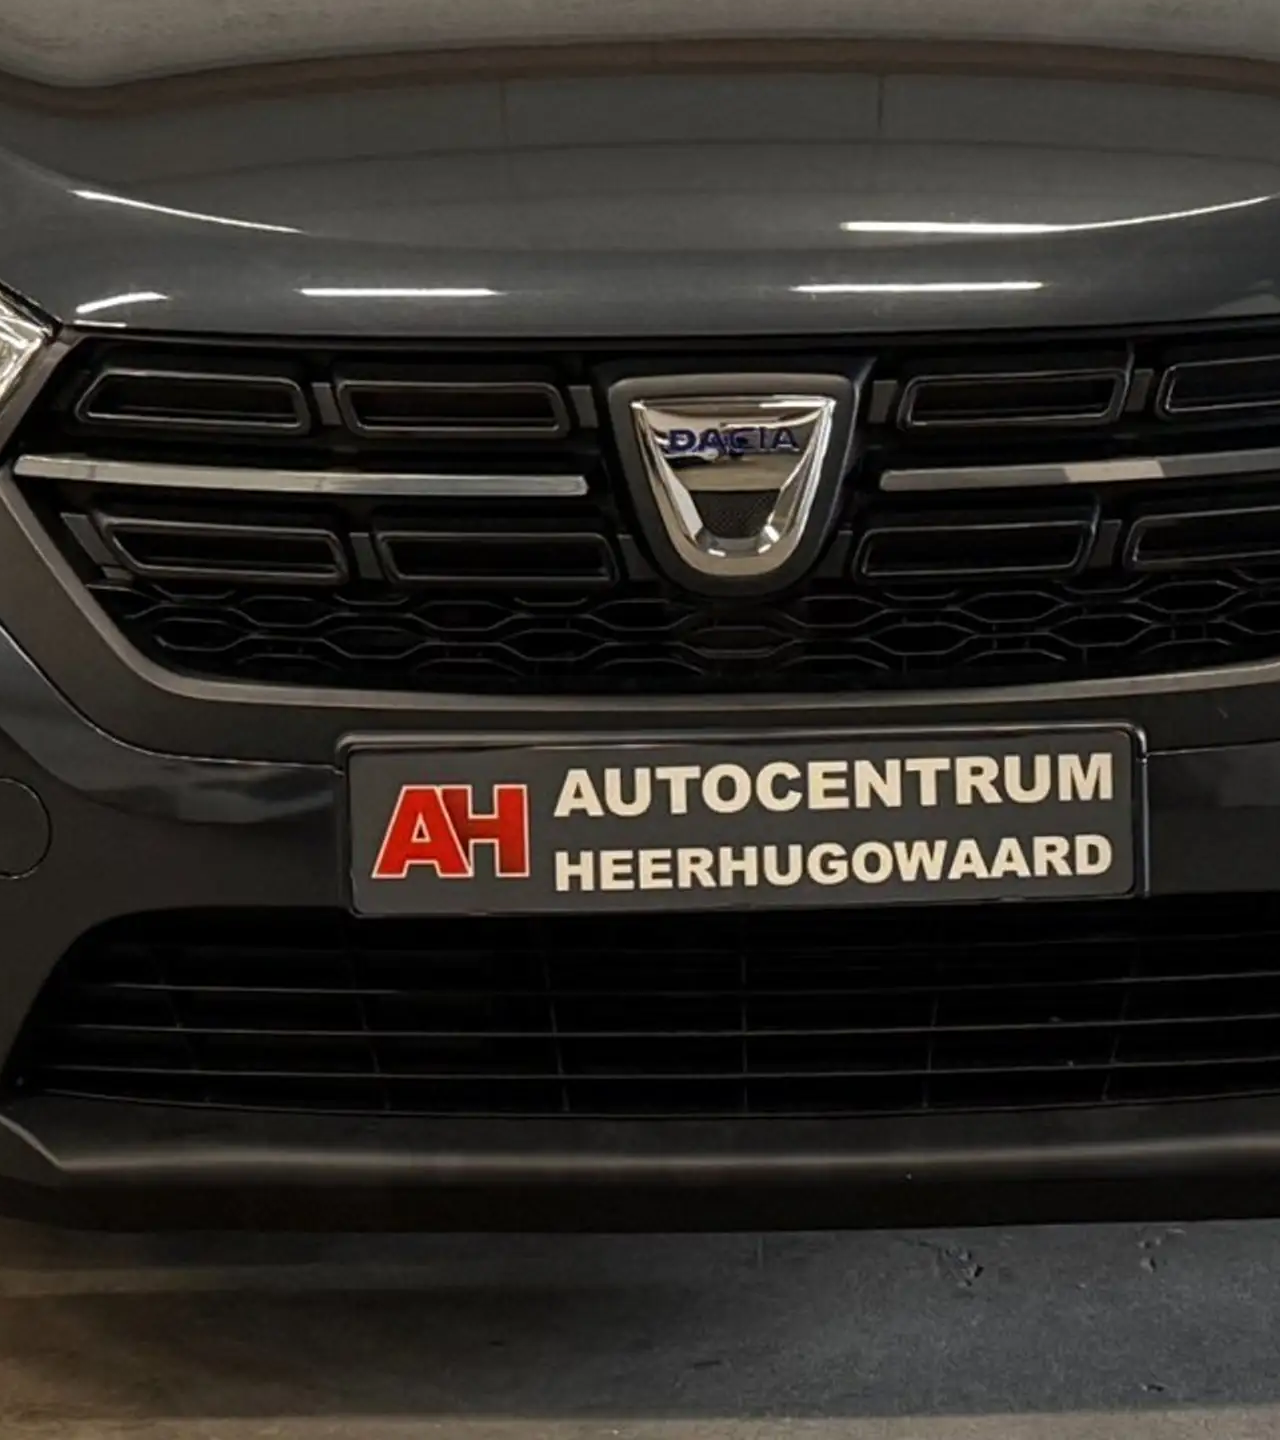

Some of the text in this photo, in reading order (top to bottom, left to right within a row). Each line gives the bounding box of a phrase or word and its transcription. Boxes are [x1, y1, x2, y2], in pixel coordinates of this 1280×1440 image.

[666, 426, 798, 452] DACIA
[553, 754, 1112, 817] AUTOCENTRUM
[373, 784, 531, 878] AH
[555, 835, 1112, 891] HEERHUGOWAARD
